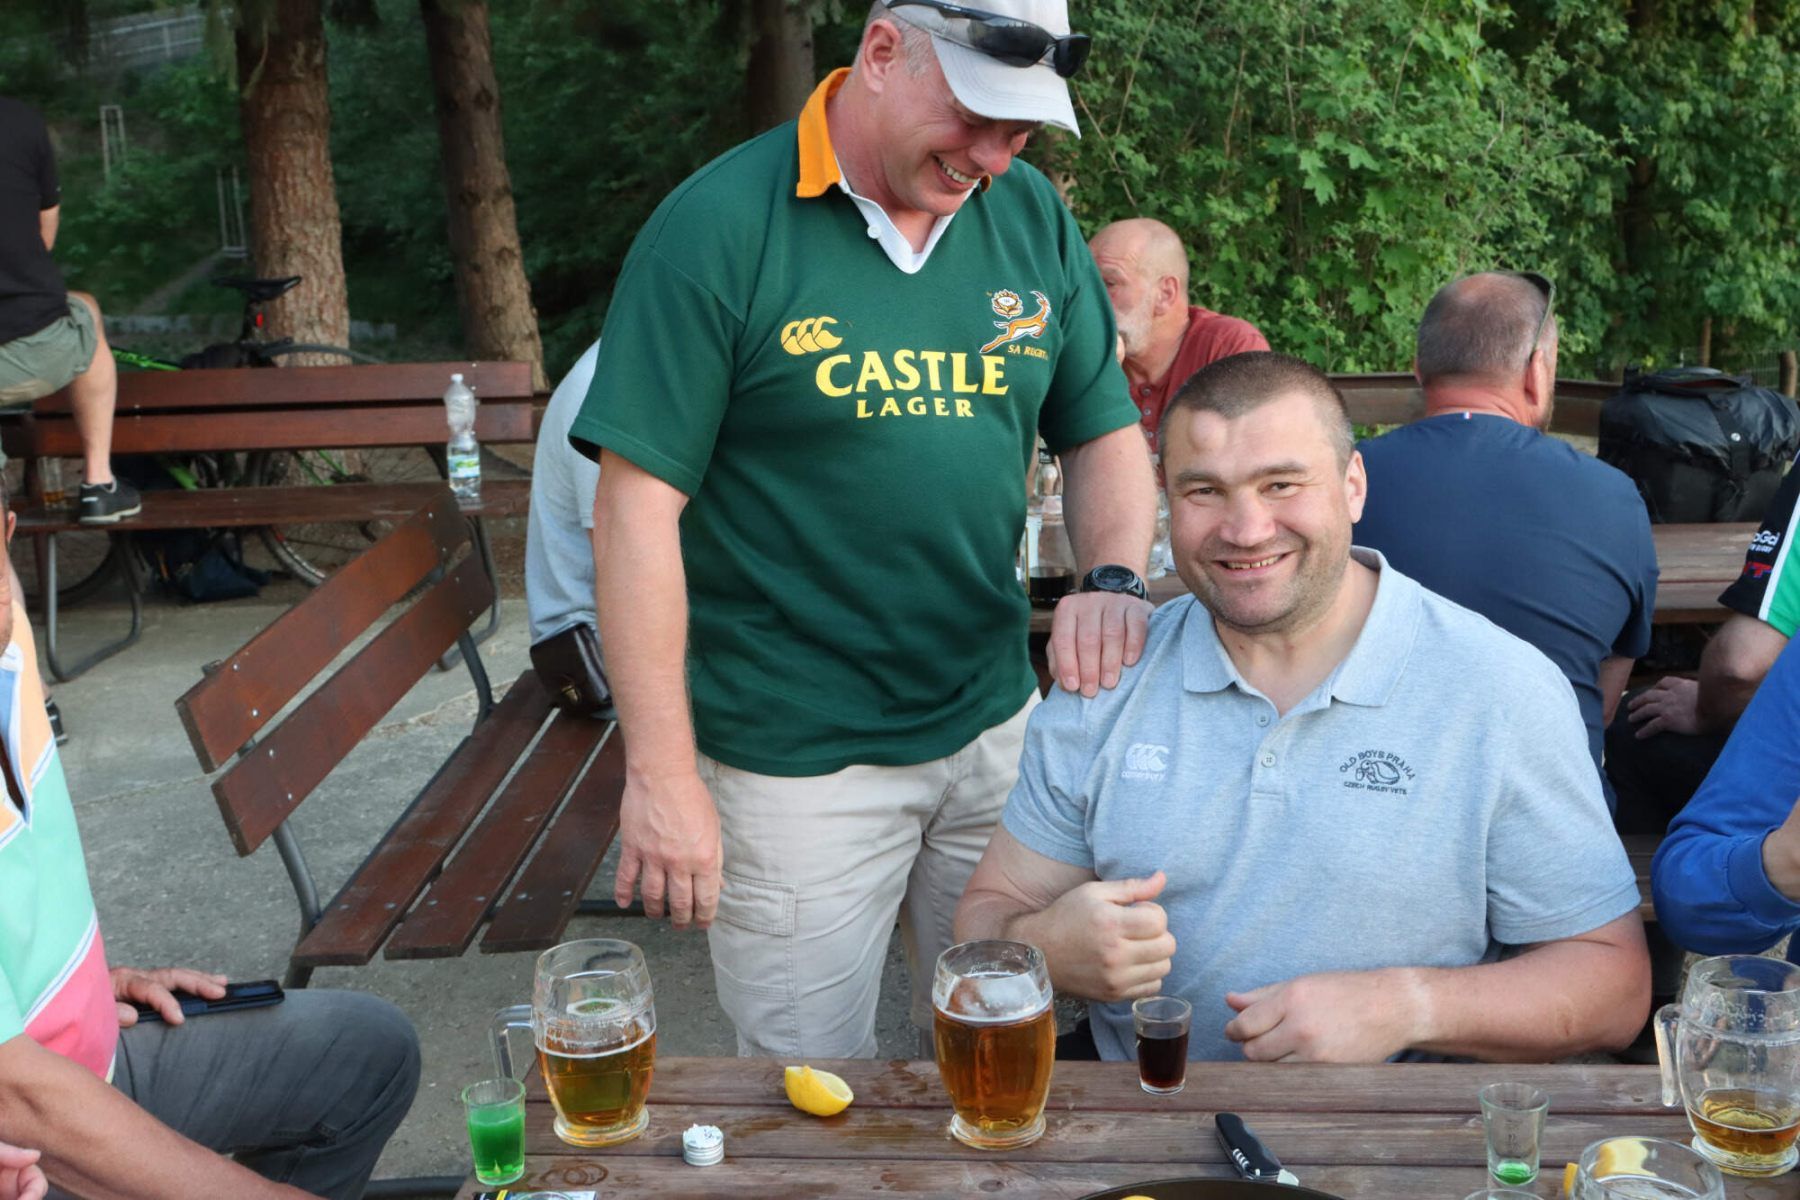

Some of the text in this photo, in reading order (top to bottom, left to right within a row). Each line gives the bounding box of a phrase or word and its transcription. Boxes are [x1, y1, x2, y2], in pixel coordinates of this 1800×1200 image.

[815, 349, 1009, 397] CASTLE
[856, 396, 975, 418] LAGER
[1340, 749, 1416, 780] OLD BOYS PRAHA
